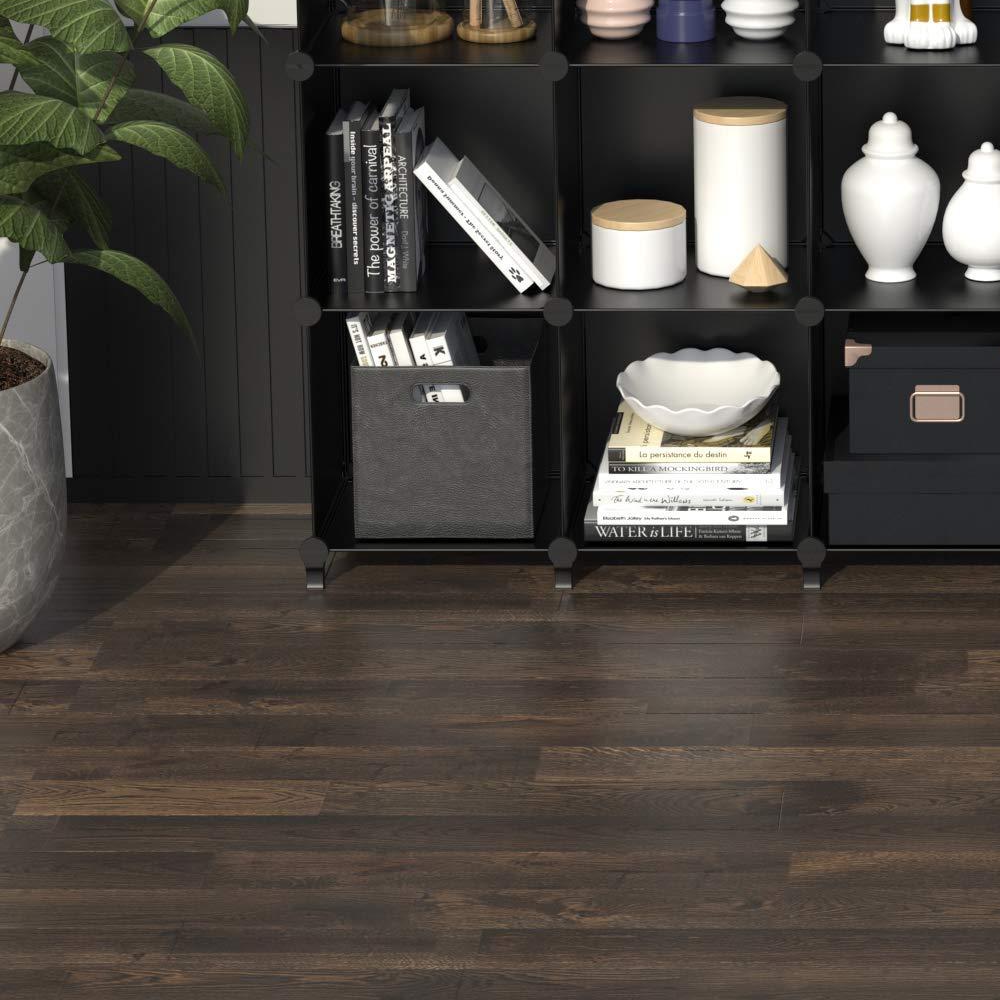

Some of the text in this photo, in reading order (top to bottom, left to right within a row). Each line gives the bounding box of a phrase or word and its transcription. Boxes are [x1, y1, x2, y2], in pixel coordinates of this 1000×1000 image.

[329, 180, 342, 249] BREATHTAKING
[363, 144, 384, 278] The power of carnival
[398, 155, 409, 219] ARCHITECTURE
[384, 194, 397, 283] MAGNETIC
[650, 451, 692, 459] persistance
[595, 525, 693, 538] WATER is LIFE
[661, 495, 691, 504] Willows
